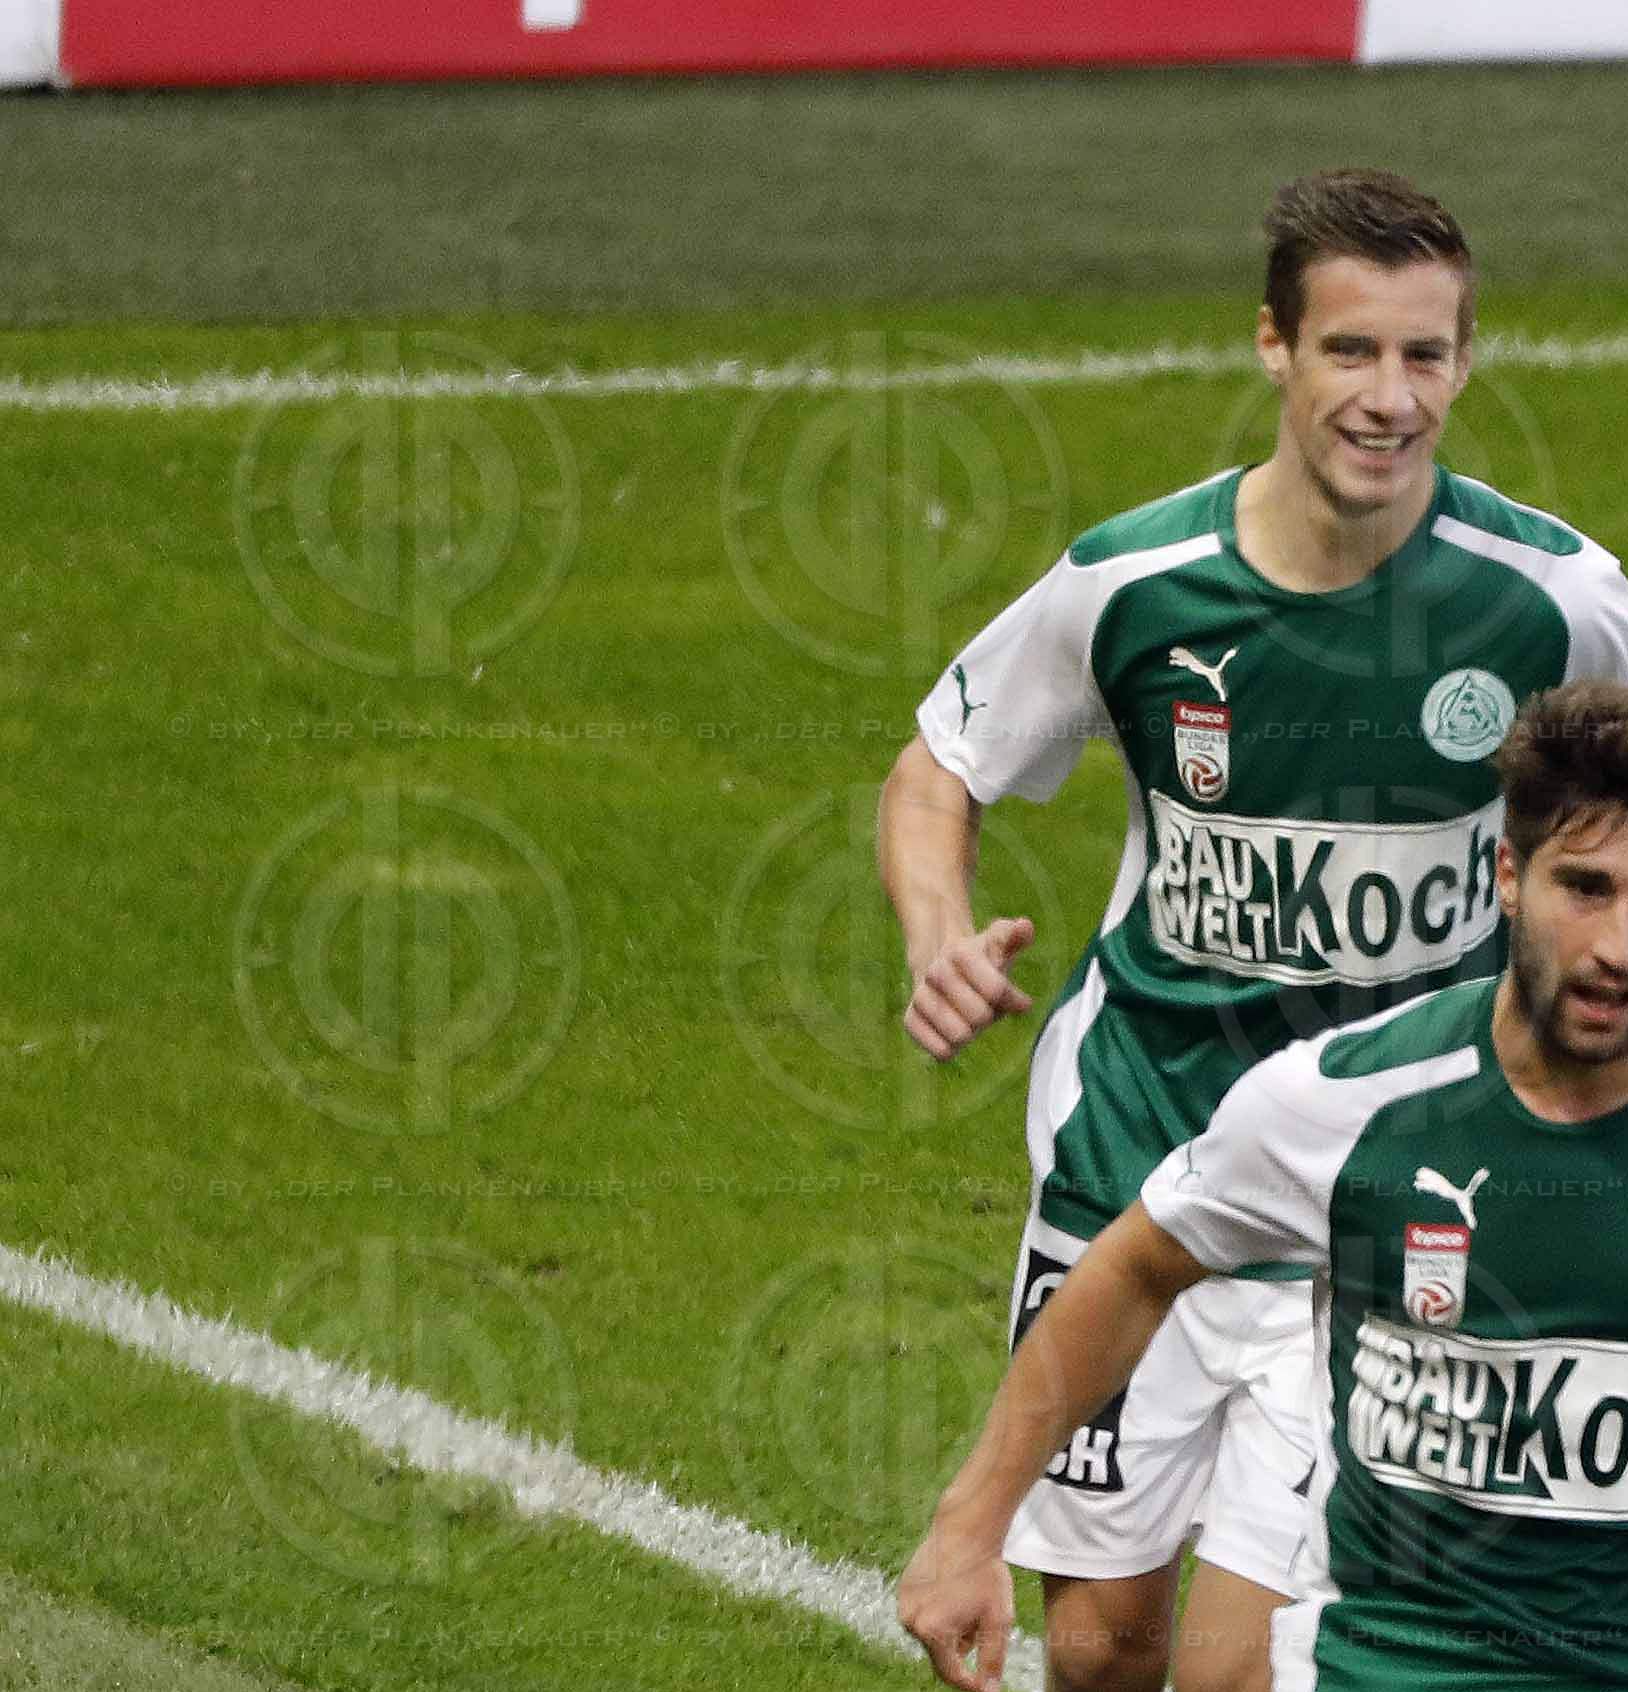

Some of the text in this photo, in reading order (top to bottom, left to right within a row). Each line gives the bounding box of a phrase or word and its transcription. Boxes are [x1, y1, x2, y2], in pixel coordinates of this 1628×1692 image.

[1159, 827, 1254, 901] BAU
[1277, 821, 1497, 969] Koch
[1154, 887, 1273, 962] WELT
[1357, 1336, 1490, 1419] BAU
[1356, 1402, 1498, 1490] WELT
